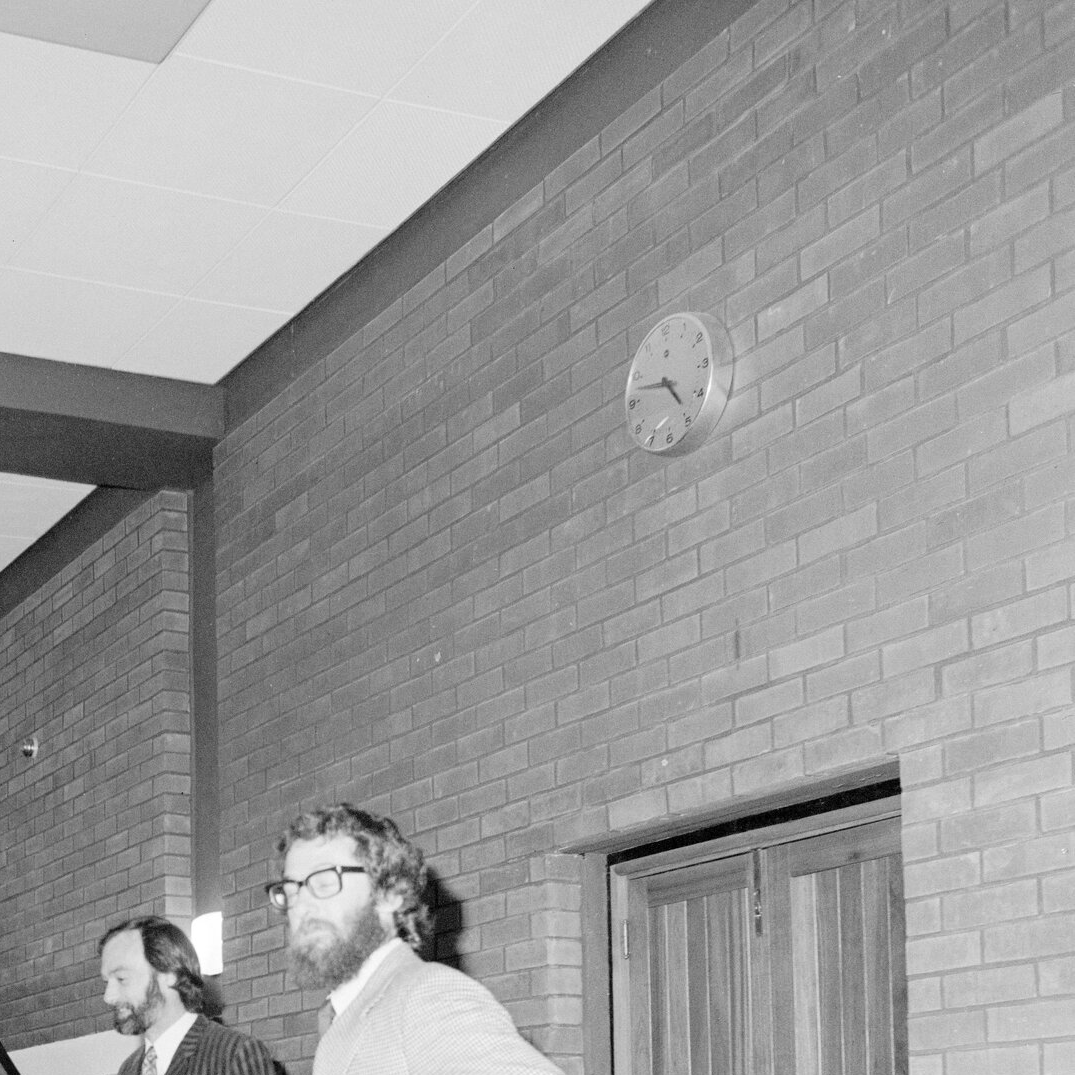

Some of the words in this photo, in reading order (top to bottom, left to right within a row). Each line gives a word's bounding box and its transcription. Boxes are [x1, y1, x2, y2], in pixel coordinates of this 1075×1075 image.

[696, 331, 704, 344] 2
[702, 357, 709, 369] 3
[697, 388, 704, 398] 4
[629, 399, 636, 410] 9
[685, 416, 692, 427] 5
[635, 424, 642, 435] 8
[649, 435, 655, 447] 7
[666, 432, 674, 444] 6
